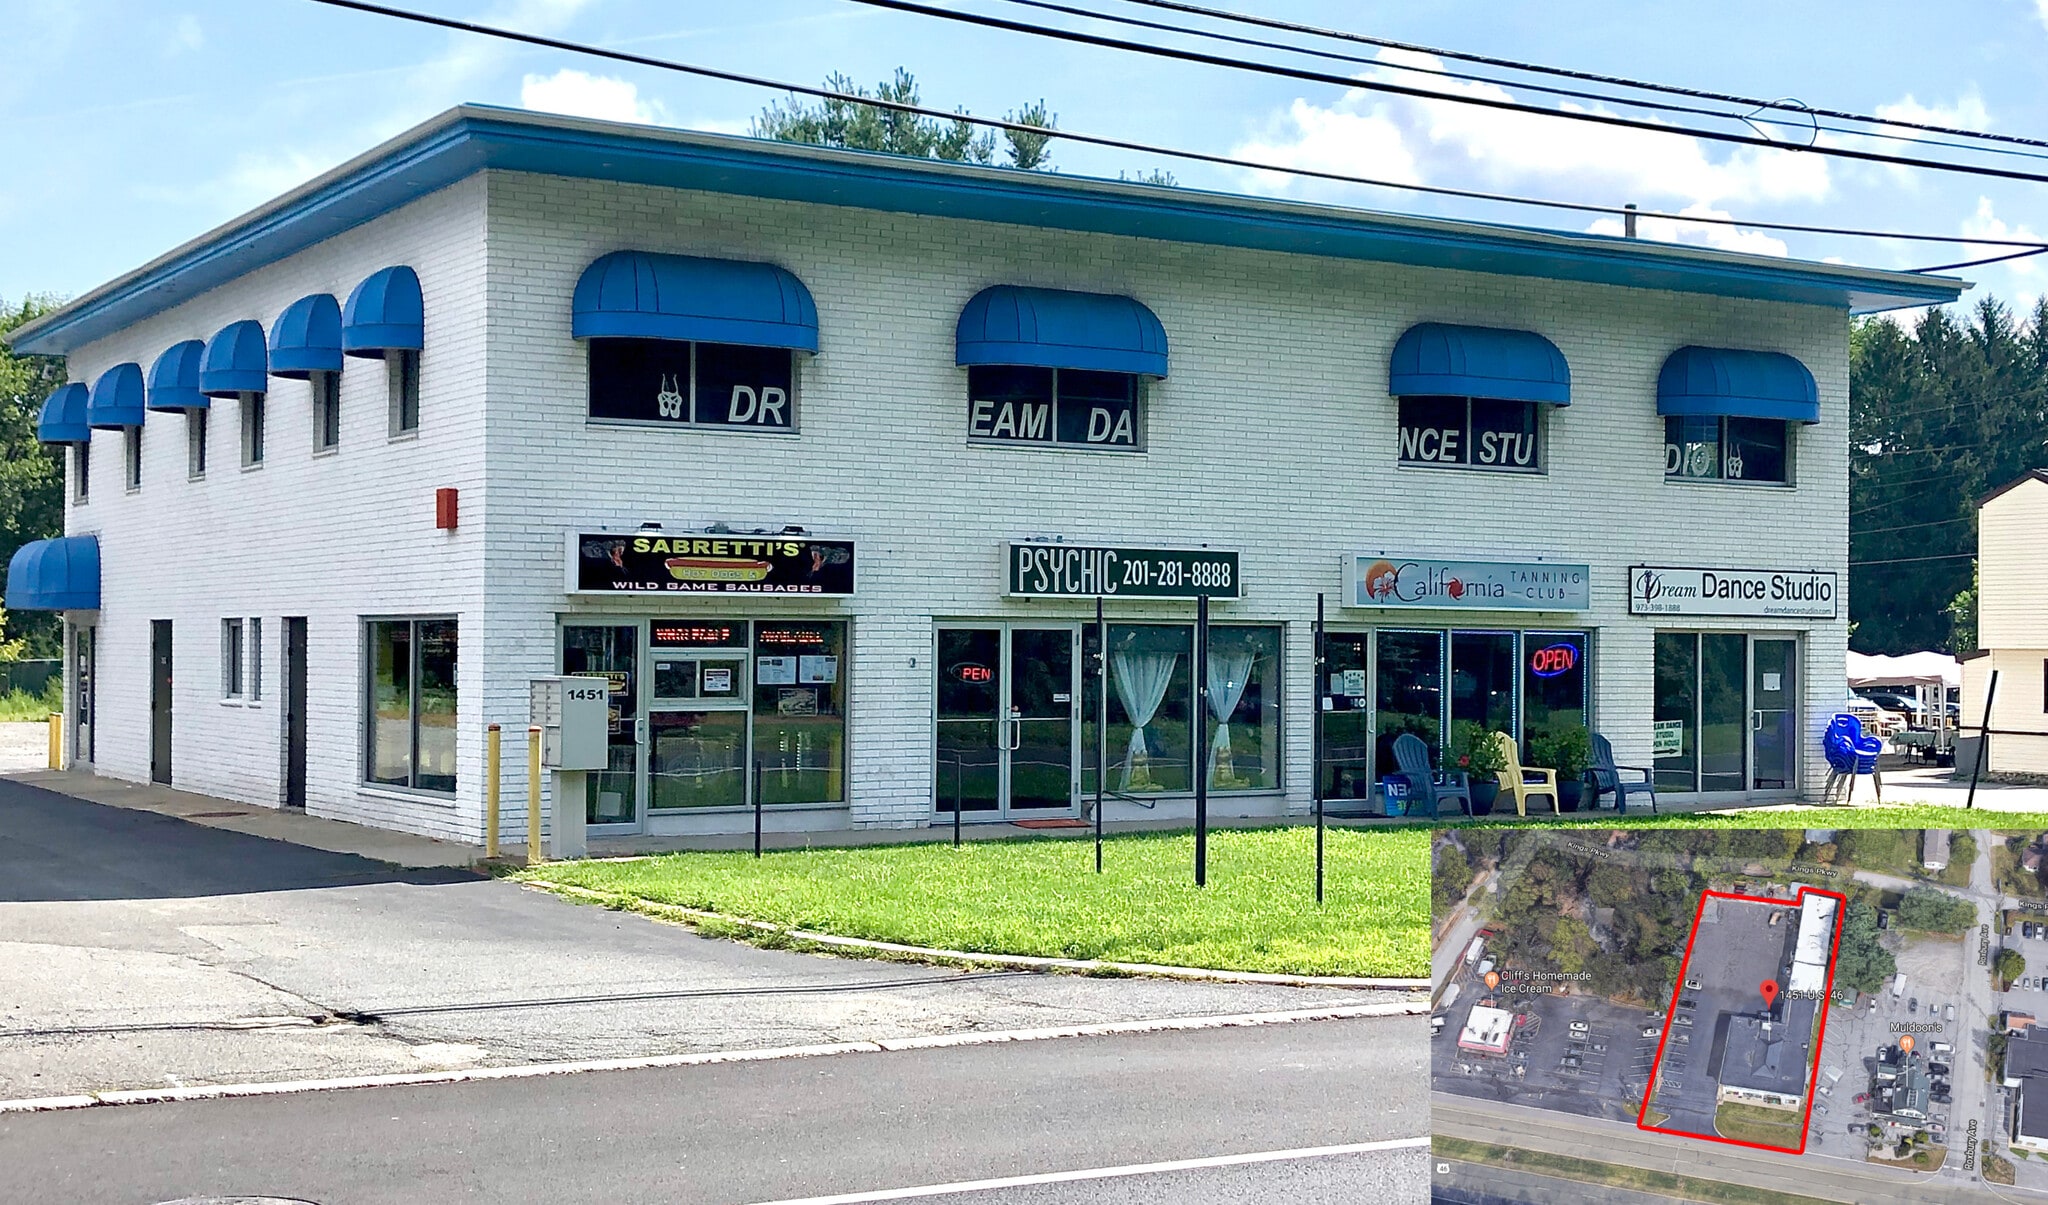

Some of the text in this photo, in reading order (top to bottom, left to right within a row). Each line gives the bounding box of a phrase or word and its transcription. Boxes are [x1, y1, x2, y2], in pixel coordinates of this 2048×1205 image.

[728, 385, 786, 425] DR
[969, 400, 1134, 444] EAM DA
[1479, 431, 1534, 465] STU
[1018, 547, 1232, 594] PSYCHIC 201-281-8888
[1510, 570, 1582, 584] TANNING
[612, 581, 823, 593] WILD GAME SAUSAGES
[1526, 586, 1566, 600] CLUB
[1634, 570, 1832, 601] Dream Dance Studio
[1532, 649, 1575, 671] OPEN
[567, 689, 604, 701] 1451
